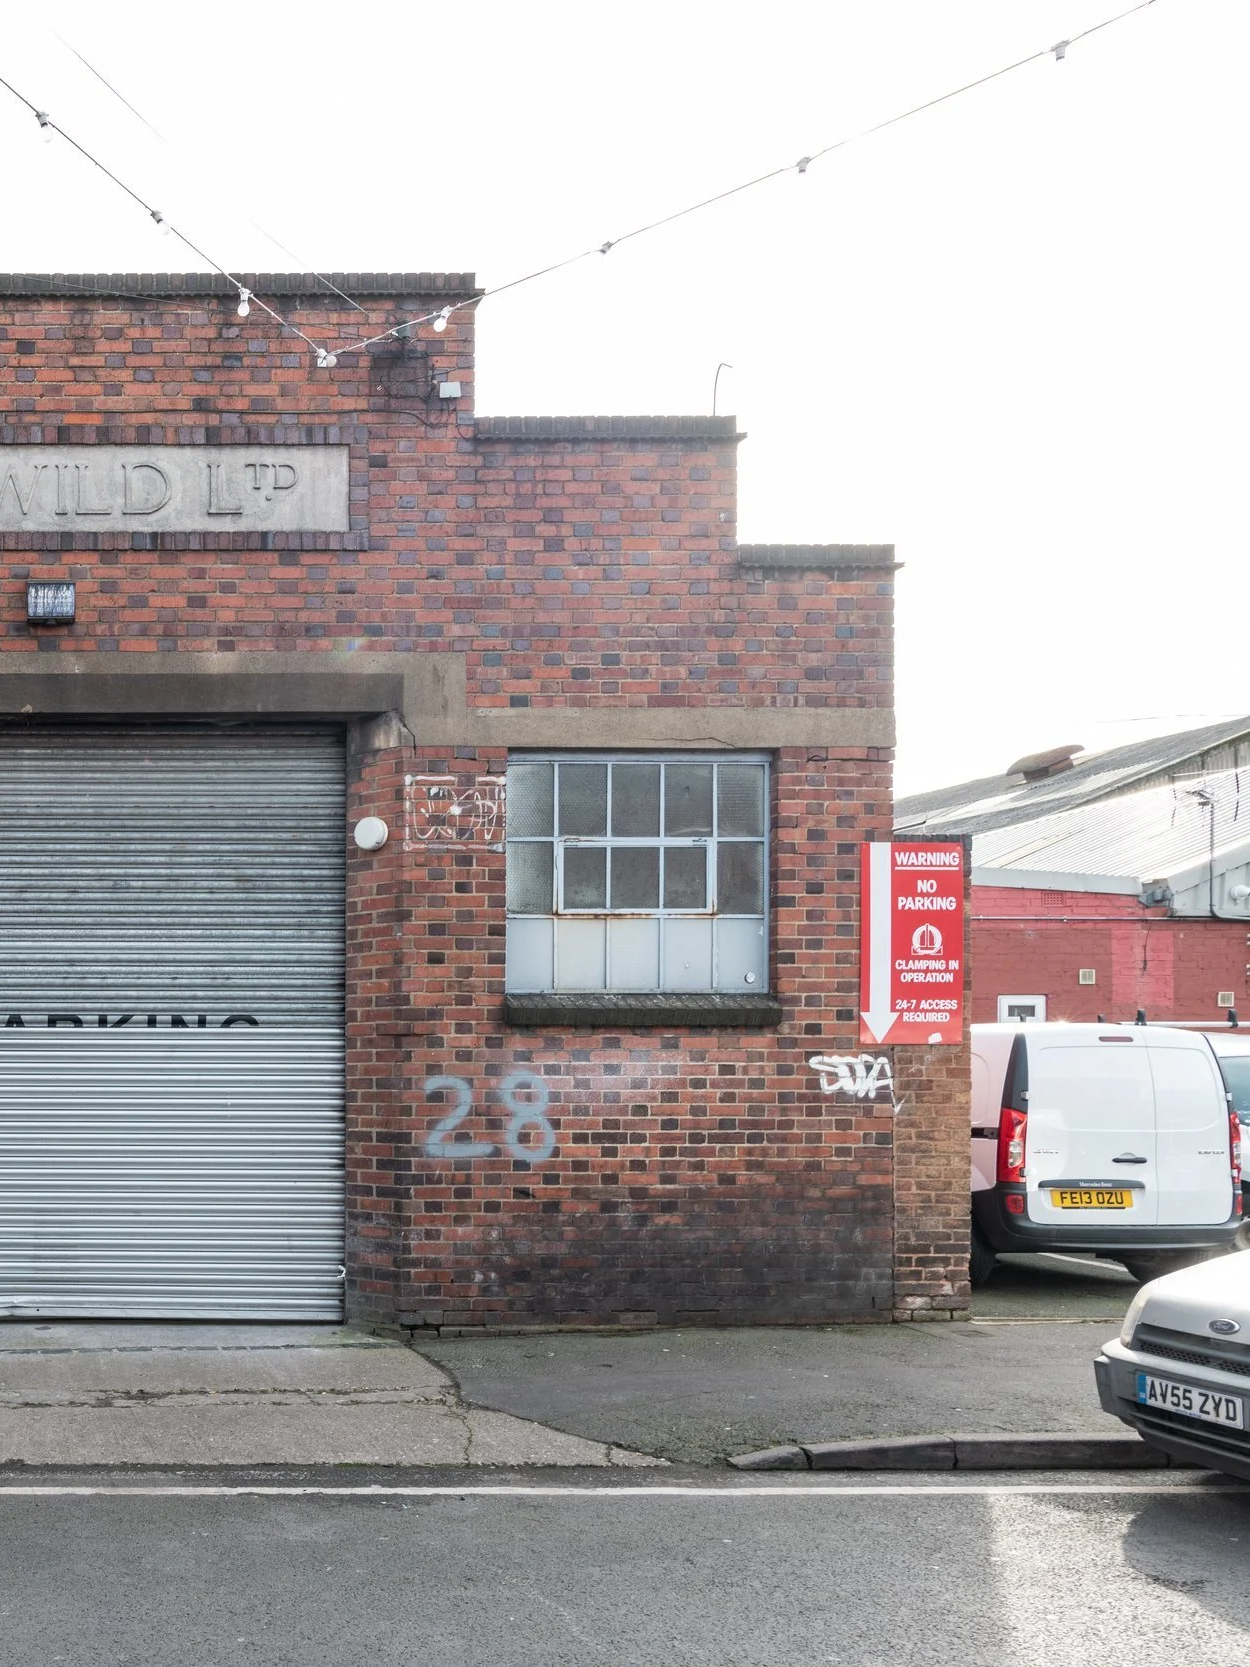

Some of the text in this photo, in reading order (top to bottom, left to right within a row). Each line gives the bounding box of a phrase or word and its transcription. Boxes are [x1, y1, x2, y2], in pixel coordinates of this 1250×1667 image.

[894, 851, 960, 866] WARNING
[916, 879, 938, 893] NO
[897, 897, 957, 911] PARKING
[895, 959, 959, 971] CLAMPING IN
[900, 972, 954, 983] OPERATION
[895, 999, 958, 1010] 24-7 ACCESS
[902, 1012, 951, 1022] REQUIRED
[424, 1069, 556, 1161] 28
[1059, 1191, 1124, 1204] FE13 OZU
[1148, 1379, 1238, 1421] AV55 ZYD
